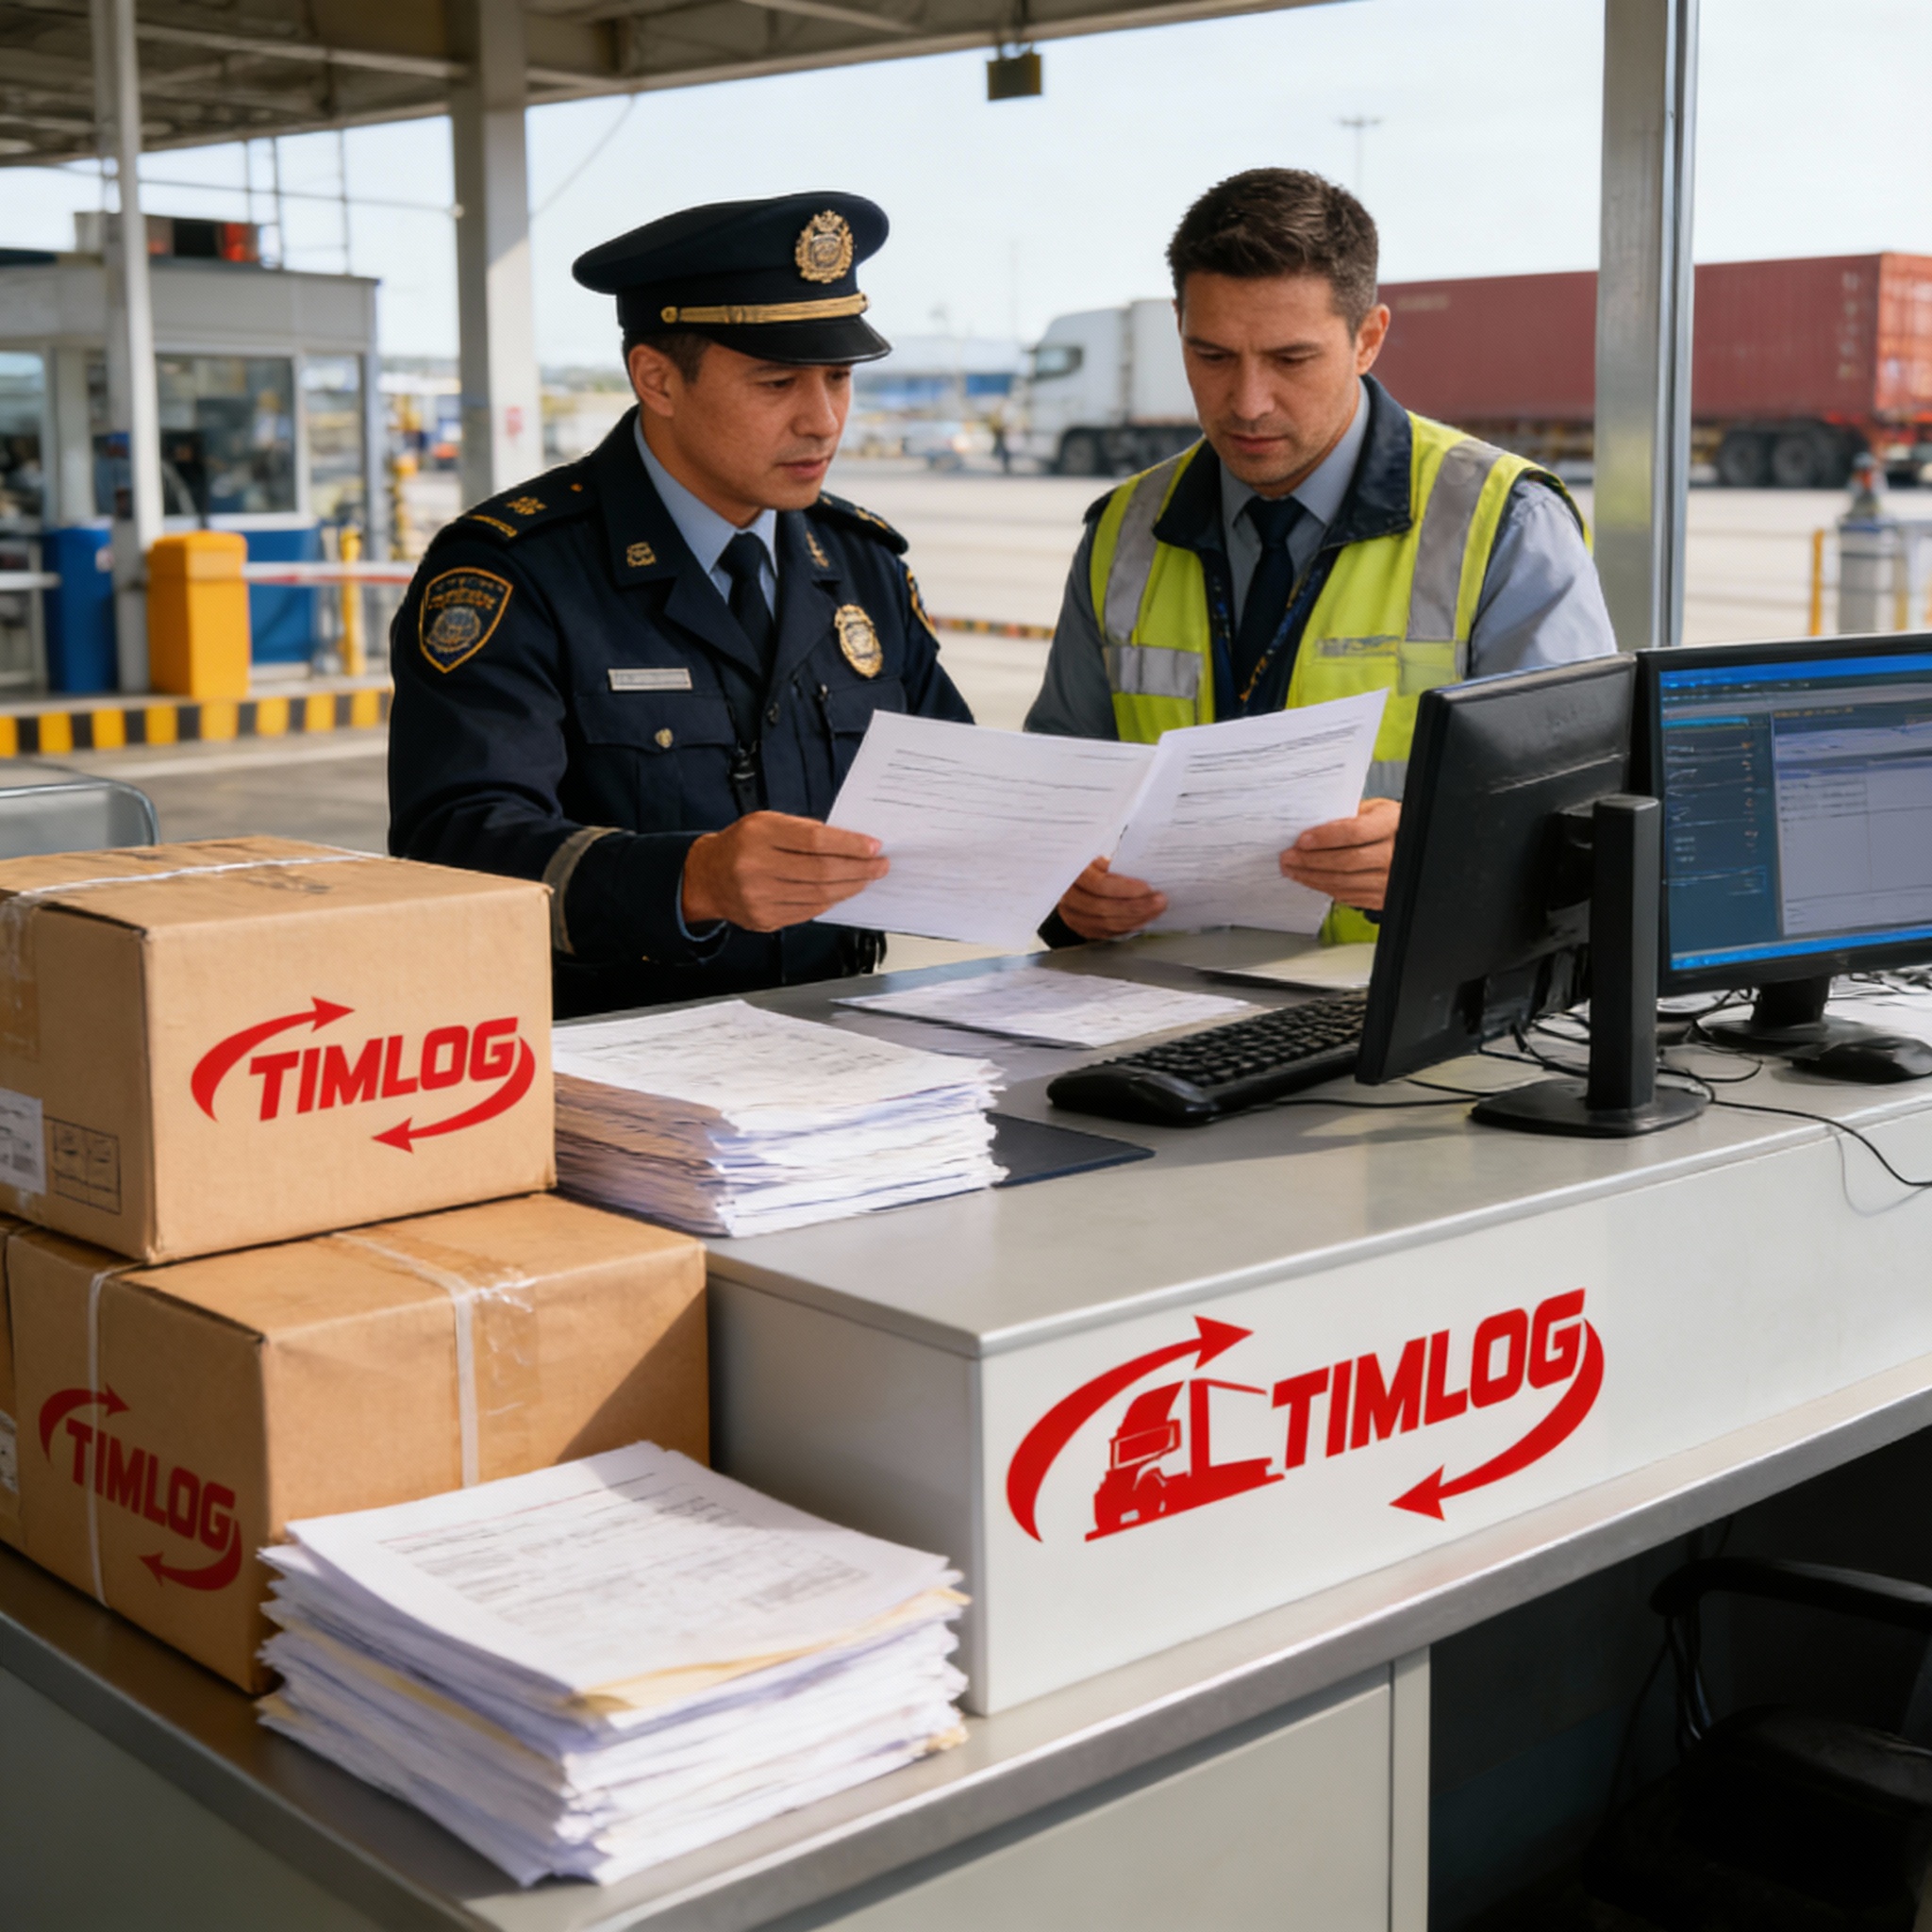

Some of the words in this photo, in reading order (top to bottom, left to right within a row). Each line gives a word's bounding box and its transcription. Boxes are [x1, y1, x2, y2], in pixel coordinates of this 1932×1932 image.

[249, 1016, 519, 1123] TIMLOG
[1272, 1288, 1586, 1470] TIMLOG
[65, 1417, 236, 1552] TIMLOG
